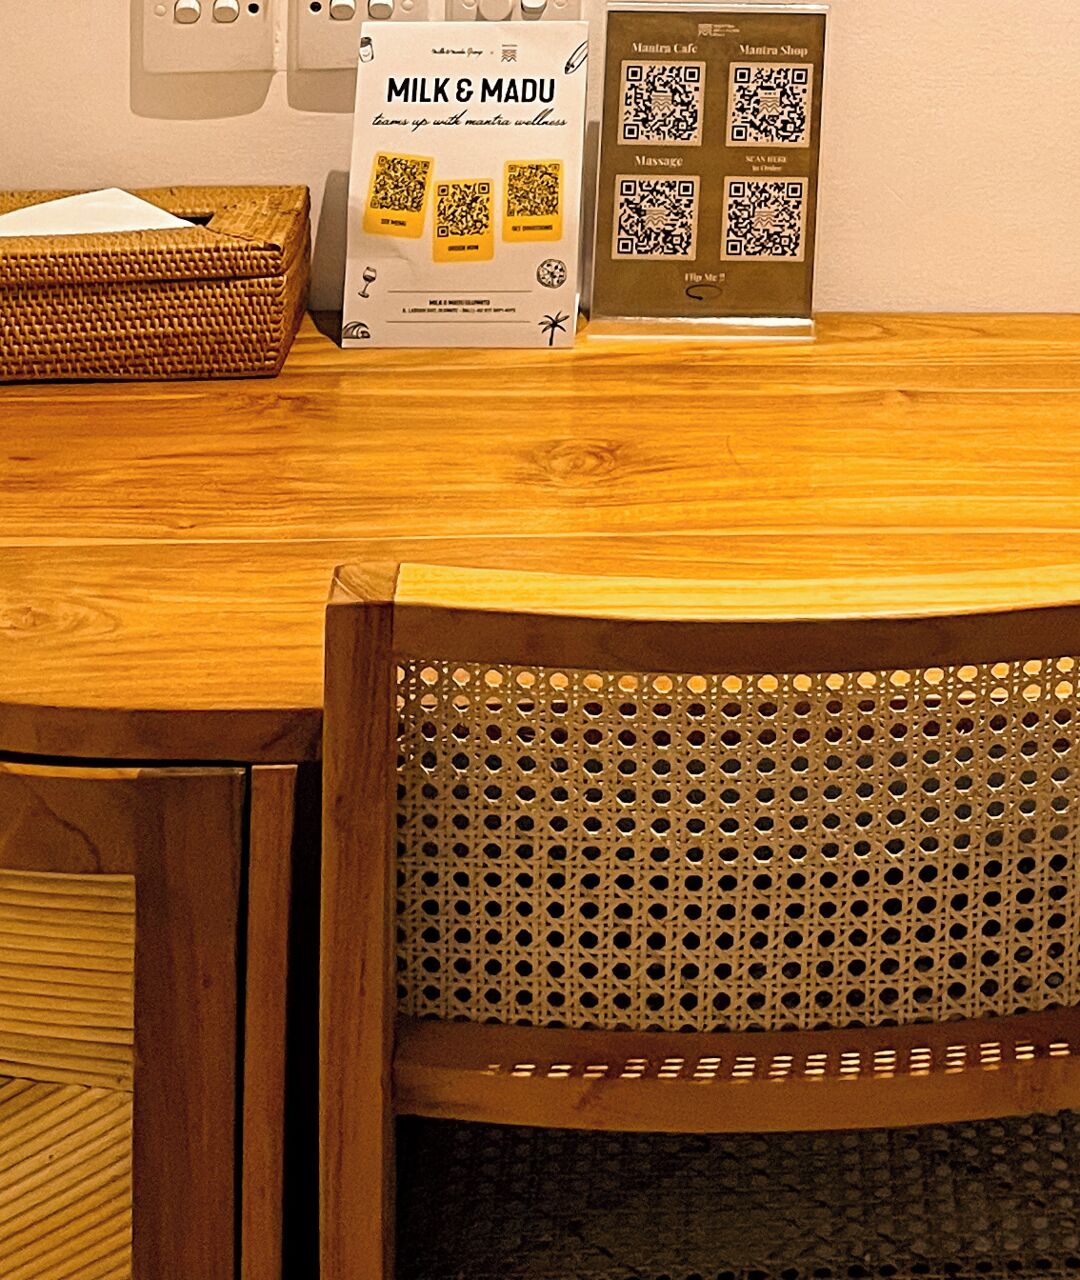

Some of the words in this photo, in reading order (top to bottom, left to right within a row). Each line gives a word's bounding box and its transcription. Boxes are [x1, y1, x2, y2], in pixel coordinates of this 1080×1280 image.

[632, 42, 672, 54] Mantra
[673, 42, 699, 54] Cafe
[739, 44, 778, 56] Mantra
[780, 45, 808, 58] Shop
[387, 77, 451, 103] MILK
[455, 78, 474, 103] &
[480, 77, 556, 103] MADU
[372, 112, 409, 126] teams
[412, 117, 430, 132] up
[433, 109, 468, 126] with
[465, 112, 510, 126] mantra
[514, 108, 568, 126] wellness
[635, 155, 684, 168] Massage
[745, 155, 766, 163] SCAN
[685, 272, 703, 282] Flip
